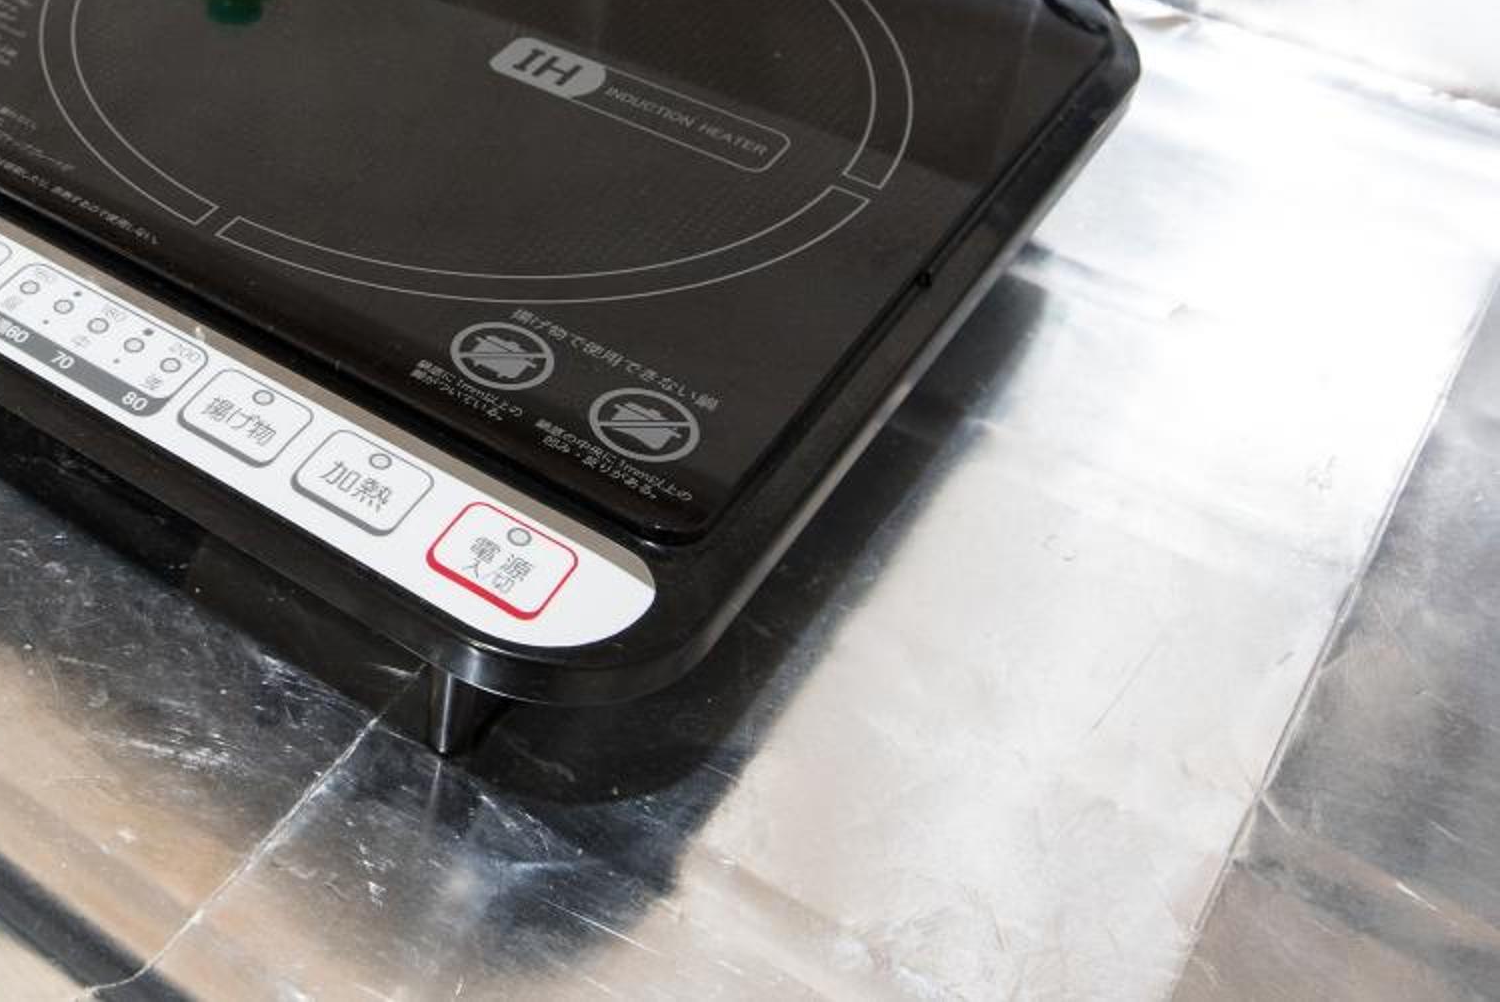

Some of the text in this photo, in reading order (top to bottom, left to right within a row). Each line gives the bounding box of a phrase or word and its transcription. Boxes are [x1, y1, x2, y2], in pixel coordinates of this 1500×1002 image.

[512, 49, 583, 86] IH
[605, 87, 769, 156] INDUCTION HEATER
[50, 352, 75, 369] 70
[121, 391, 148, 411] 80
[201, 397, 276, 446] 揚げ物
[320, 460, 392, 513] 加熱
[470, 537, 534, 583] 電源
